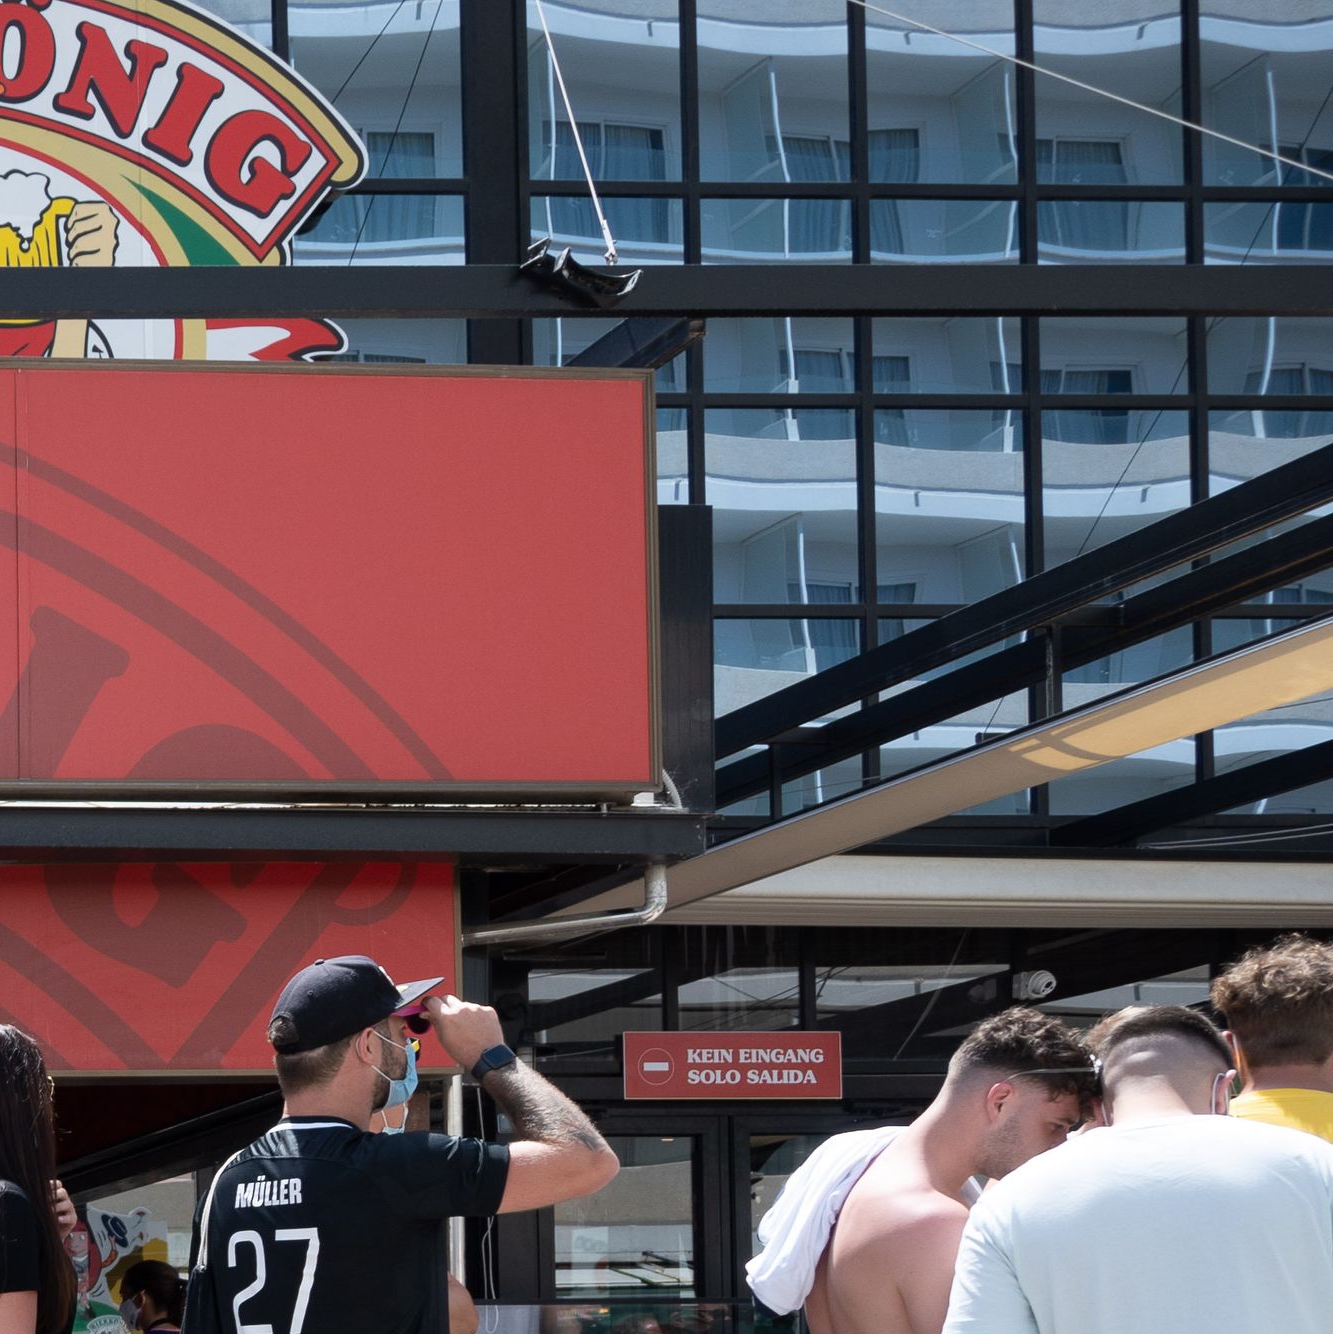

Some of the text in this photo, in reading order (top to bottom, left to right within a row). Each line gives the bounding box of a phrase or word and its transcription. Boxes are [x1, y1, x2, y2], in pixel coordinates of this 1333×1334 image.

[687, 1048, 824, 1064] KEIN EINGANG
[687, 1069, 817, 1085] SOLO SALIDA
[234, 1175, 303, 1209] MÜLLER
